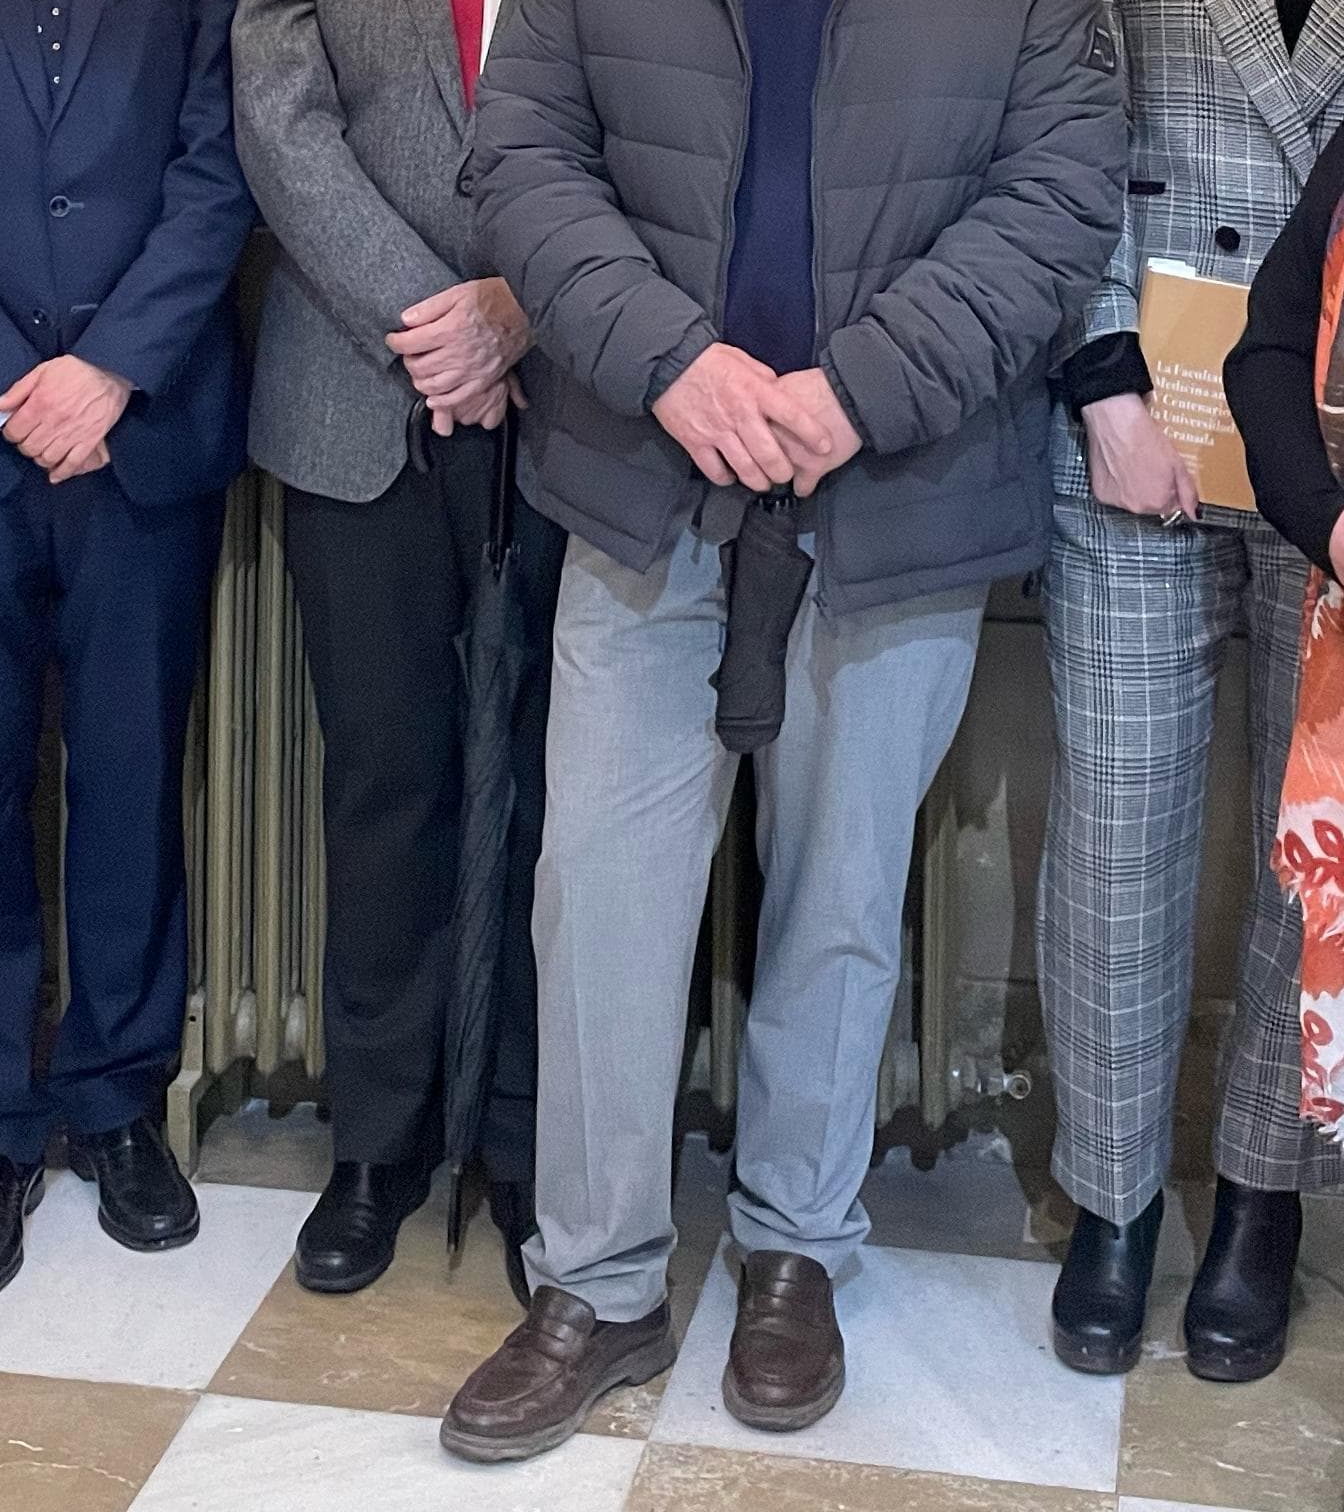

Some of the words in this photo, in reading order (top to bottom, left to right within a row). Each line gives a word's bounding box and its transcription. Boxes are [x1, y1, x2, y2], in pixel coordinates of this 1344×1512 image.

[1157, 360, 1172, 374] La
[1163, 409, 1236, 433] Universidad
[1163, 426, 1215, 446] Granada
